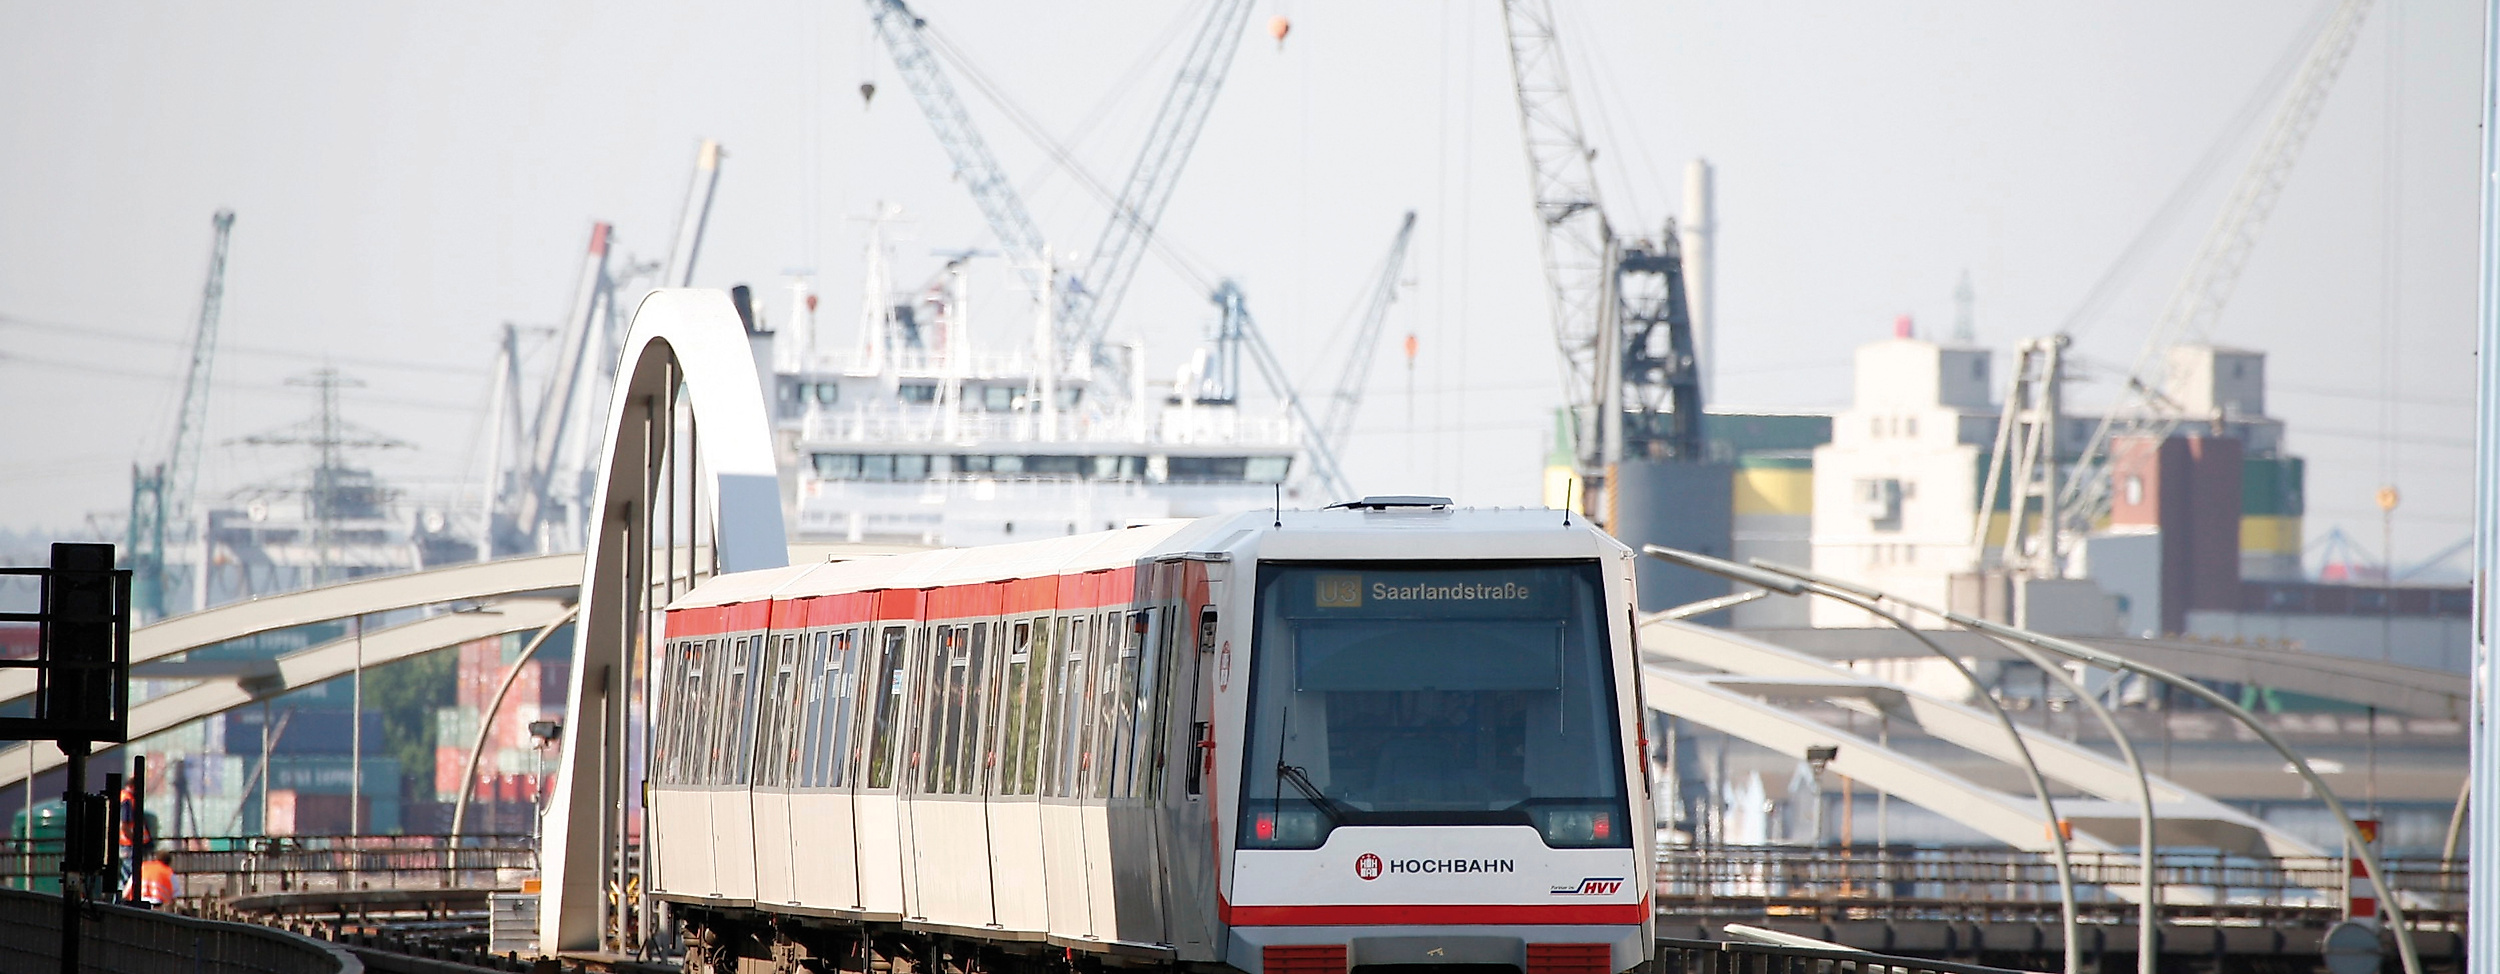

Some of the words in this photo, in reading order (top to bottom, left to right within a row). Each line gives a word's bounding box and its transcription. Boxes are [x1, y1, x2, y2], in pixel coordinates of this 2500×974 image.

[1320, 580, 1357, 602] U3
[1372, 582, 1529, 600] Saarlandstraße
[1390, 859, 1514, 873] HOCHBAHN
[1584, 882, 1622, 894] HVV
